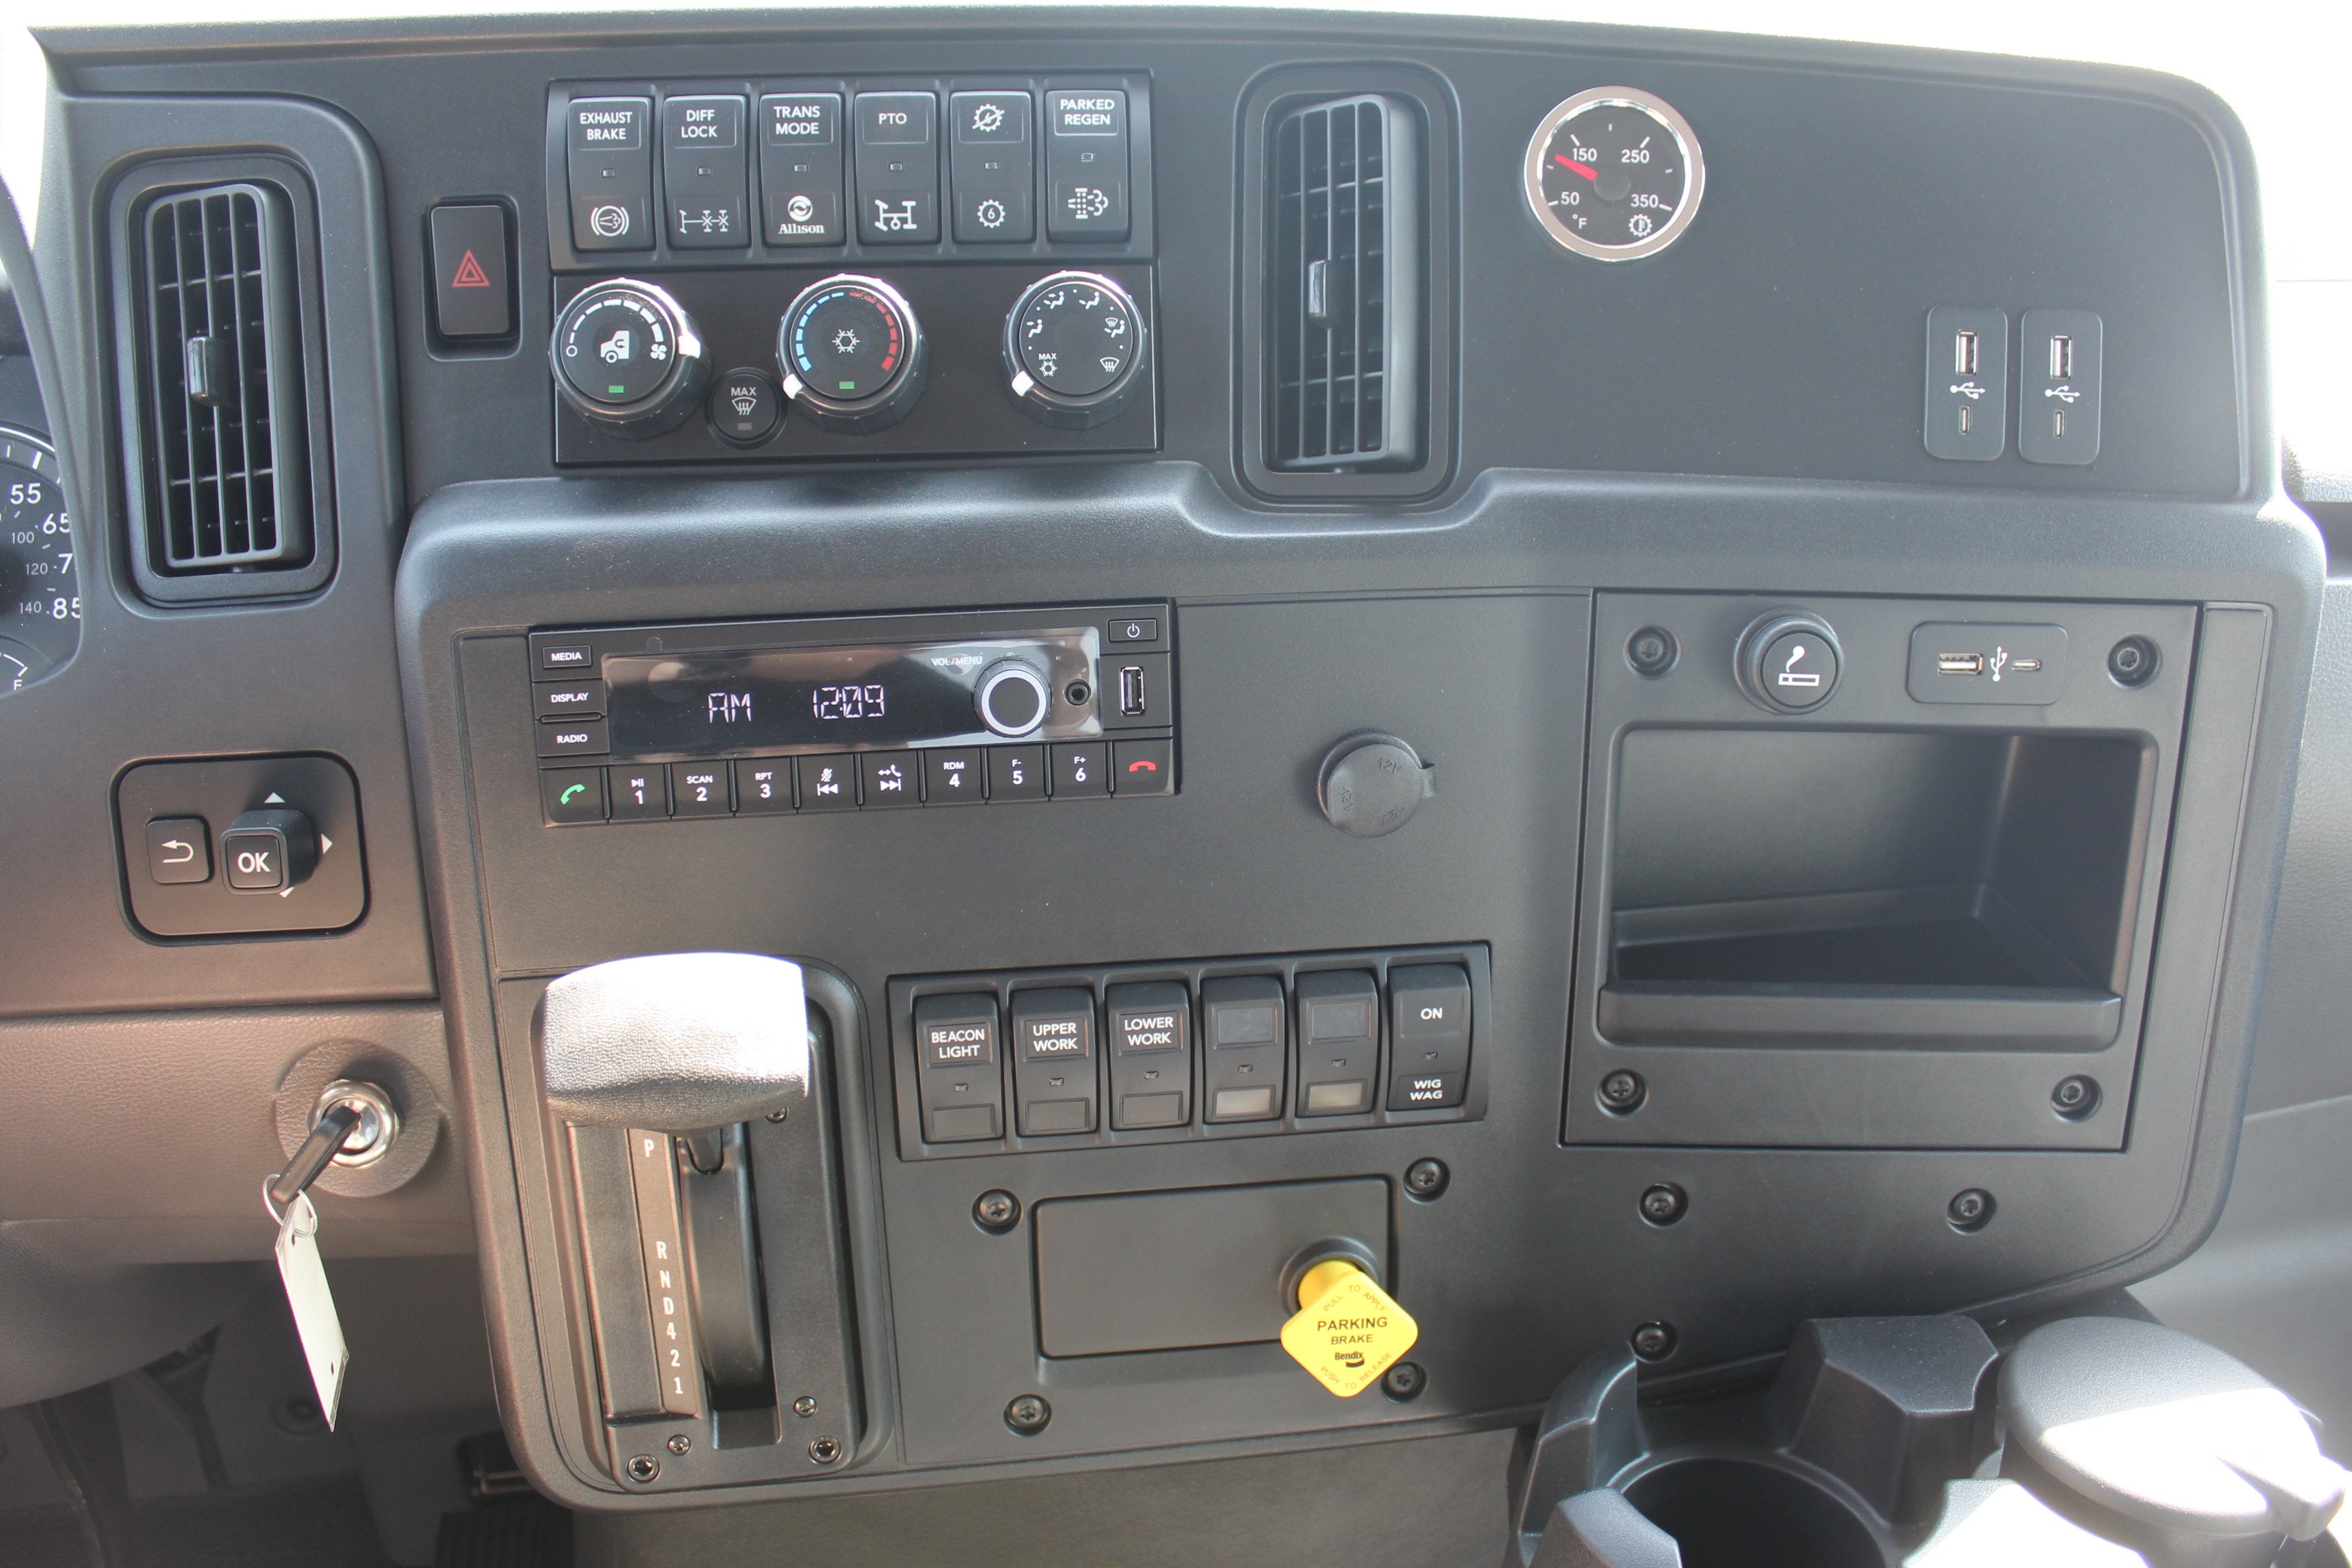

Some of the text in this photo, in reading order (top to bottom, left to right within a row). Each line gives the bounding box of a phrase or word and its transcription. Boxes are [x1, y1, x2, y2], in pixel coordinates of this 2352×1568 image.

[1060, 99, 1115, 111] PARKED
[580, 111, 633, 125] EXHAUST
[686, 110, 715, 122] DIFF
[773, 105, 821, 119] TRANS
[878, 112, 908, 125] PTO
[1064, 114, 1111, 126] REGEN
[587, 128, 626, 141] BRAKE
[681, 125, 718, 139] LOCK
[775, 122, 820, 135] MODE
[1572, 148, 1597, 162] 150
[1621, 149, 1650, 163] 250
[1561, 191, 1580, 206] 50
[1631, 194, 1659, 208] 350
[778, 223, 826, 235] Allison
[1039, 353, 1058, 361] MAX
[731, 387, 757, 397] MAX
[10, 483, 41, 504] 55
[12, 532, 34, 544] 100
[26, 563, 48, 575] 120
[20, 601, 42, 614] 140
[551, 652, 583, 662] MEDIA
[931, 655, 983, 668] VOL/MENU
[14, 679, 22, 691] F
[551, 692, 589, 703] DISPLAY
[708, 685, 885, 723] AM 12:09
[557, 734, 588, 744] RADIO
[943, 762, 965, 770] RDM
[1012, 759, 1022, 768] F-
[1074, 756, 1086, 765] F+
[686, 774, 714, 785] SCAN
[755, 771, 773, 781] RPT
[949, 774, 960, 789] 4
[1012, 770, 1023, 785] 5
[1075, 768, 1086, 783] 6
[634, 789, 644, 805] 1
[696, 787, 708, 802] 2
[760, 783, 771, 799] 3
[238, 852, 271, 873] OK
[1420, 1008, 1443, 1020] ON
[1033, 1022, 1077, 1036] UPPER
[1124, 1016, 1174, 1031] LOWER
[931, 1028, 985, 1044] BEACON
[1128, 1032, 1172, 1047] WORK
[1034, 1038, 1078, 1052] WORK
[938, 1045, 980, 1060] LIGHT
[1414, 1079, 1441, 1090] WIG
[1409, 1090, 1443, 1101] WAG
[644, 1139, 683, 1395] P R N D 4 2 1
[1323, 1294, 1343, 1312] PULL
[1363, 1292, 1387, 1312] APPLY
[1318, 1317, 1388, 1332] PARKING
[1330, 1334, 1373, 1345] BRAKE
[1335, 1351, 1364, 1360] Bendix
[1320, 1366, 1340, 1384] PUSH
[1359, 1352, 1392, 1383] RELEASE
